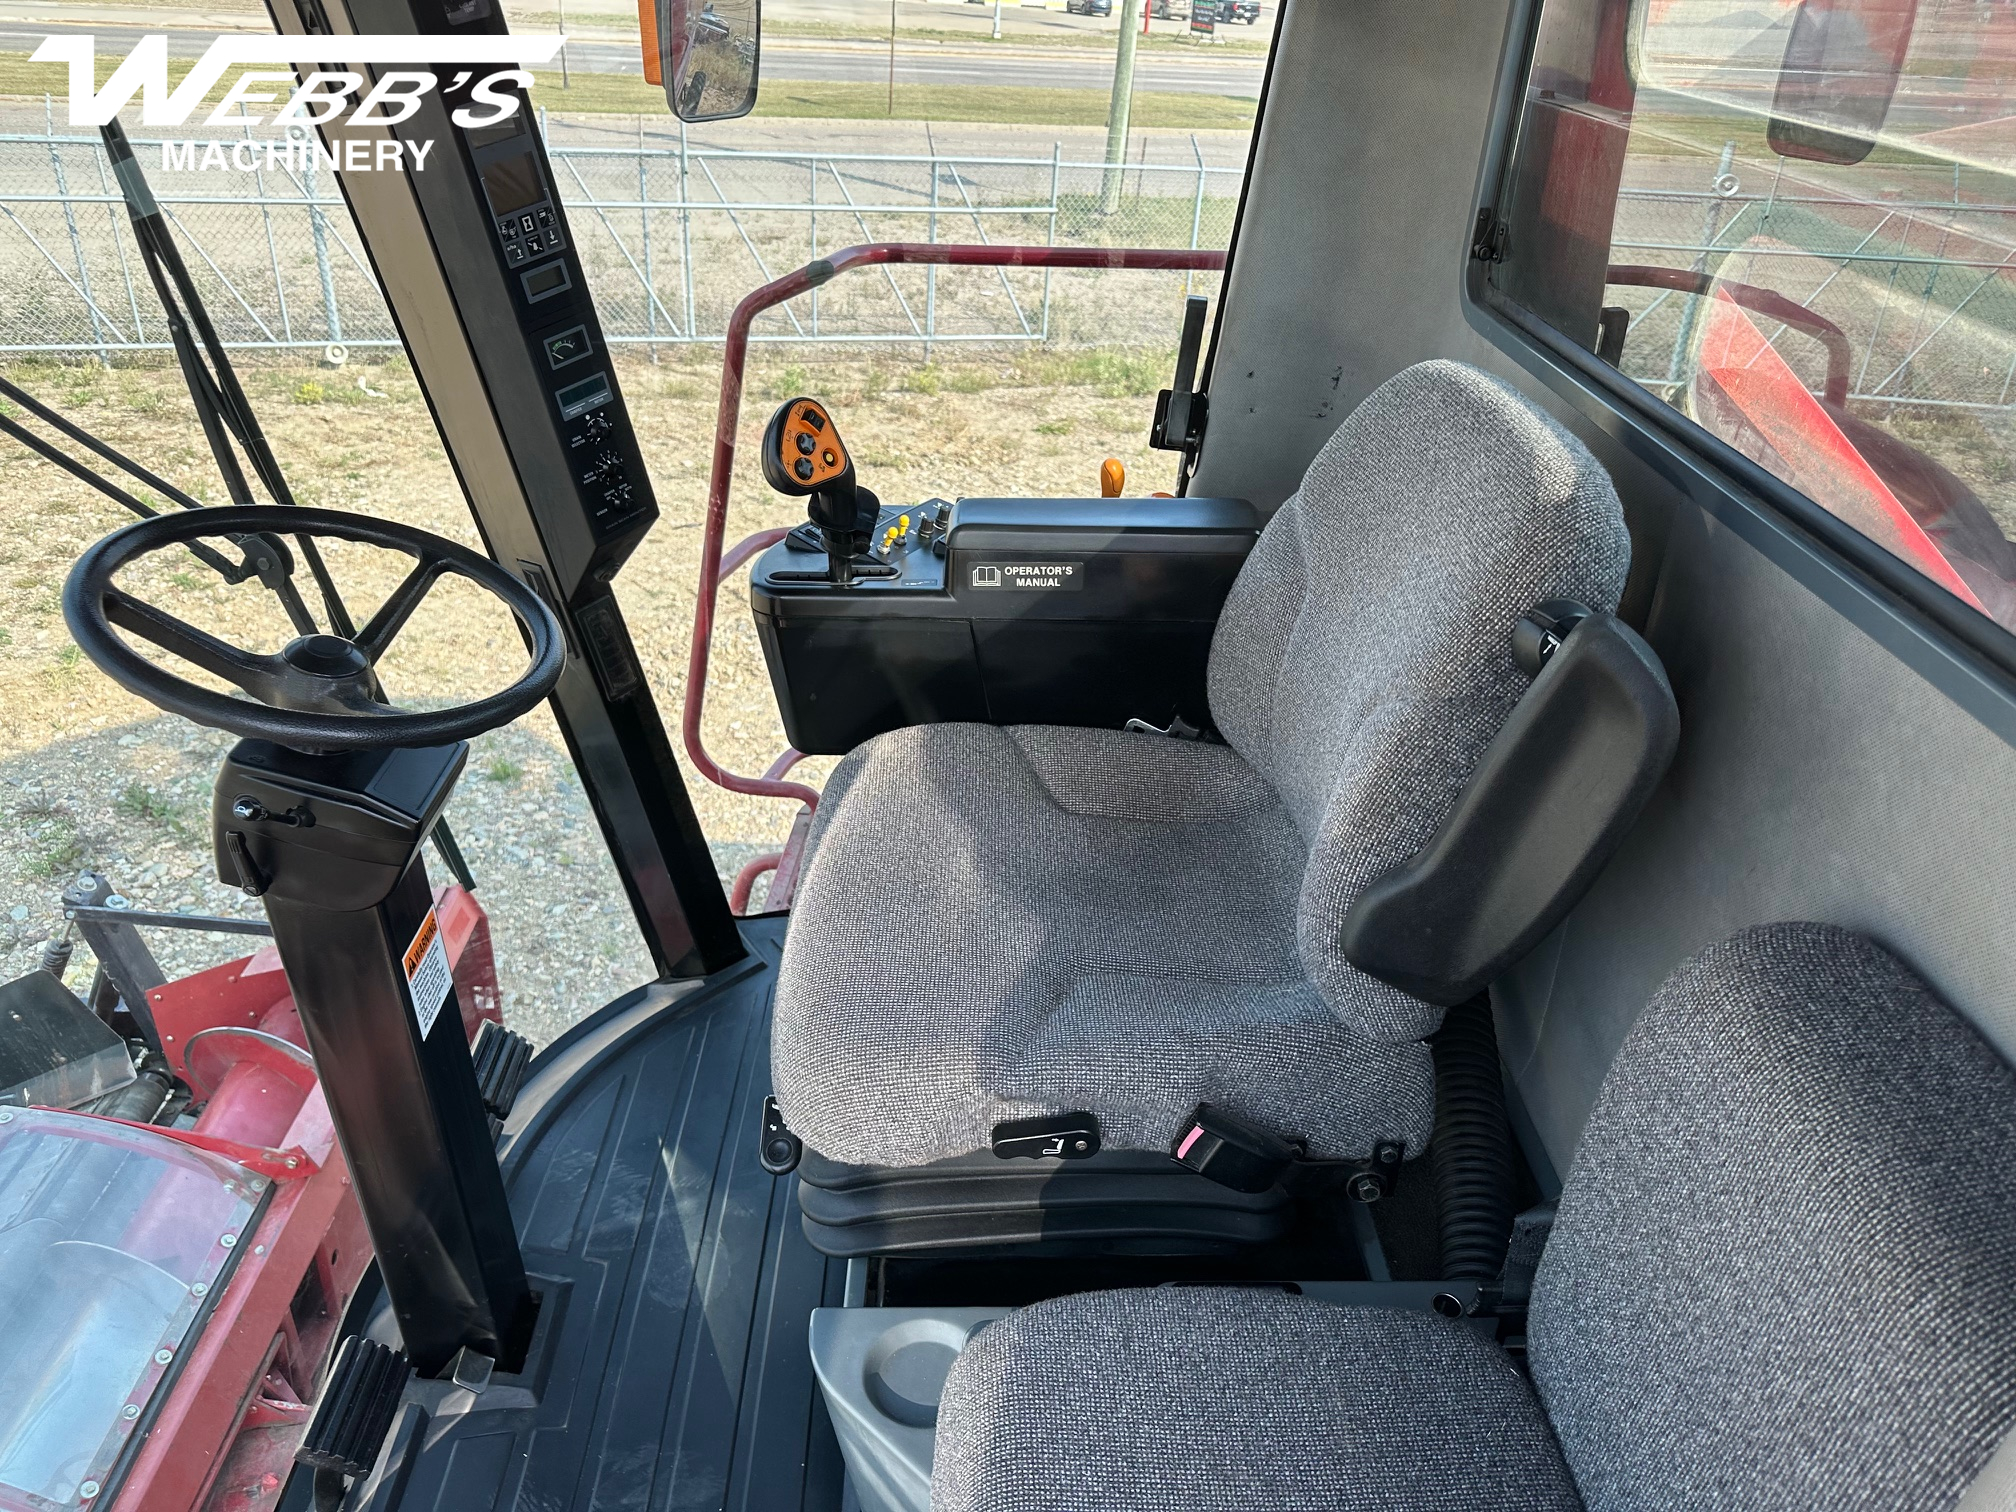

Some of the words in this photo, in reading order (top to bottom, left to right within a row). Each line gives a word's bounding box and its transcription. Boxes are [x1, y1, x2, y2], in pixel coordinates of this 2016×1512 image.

[1004, 566, 1073, 576] OPERATOR'S
[1016, 577, 1061, 587] MANUAL
[413, 918, 438, 963] WARNING
